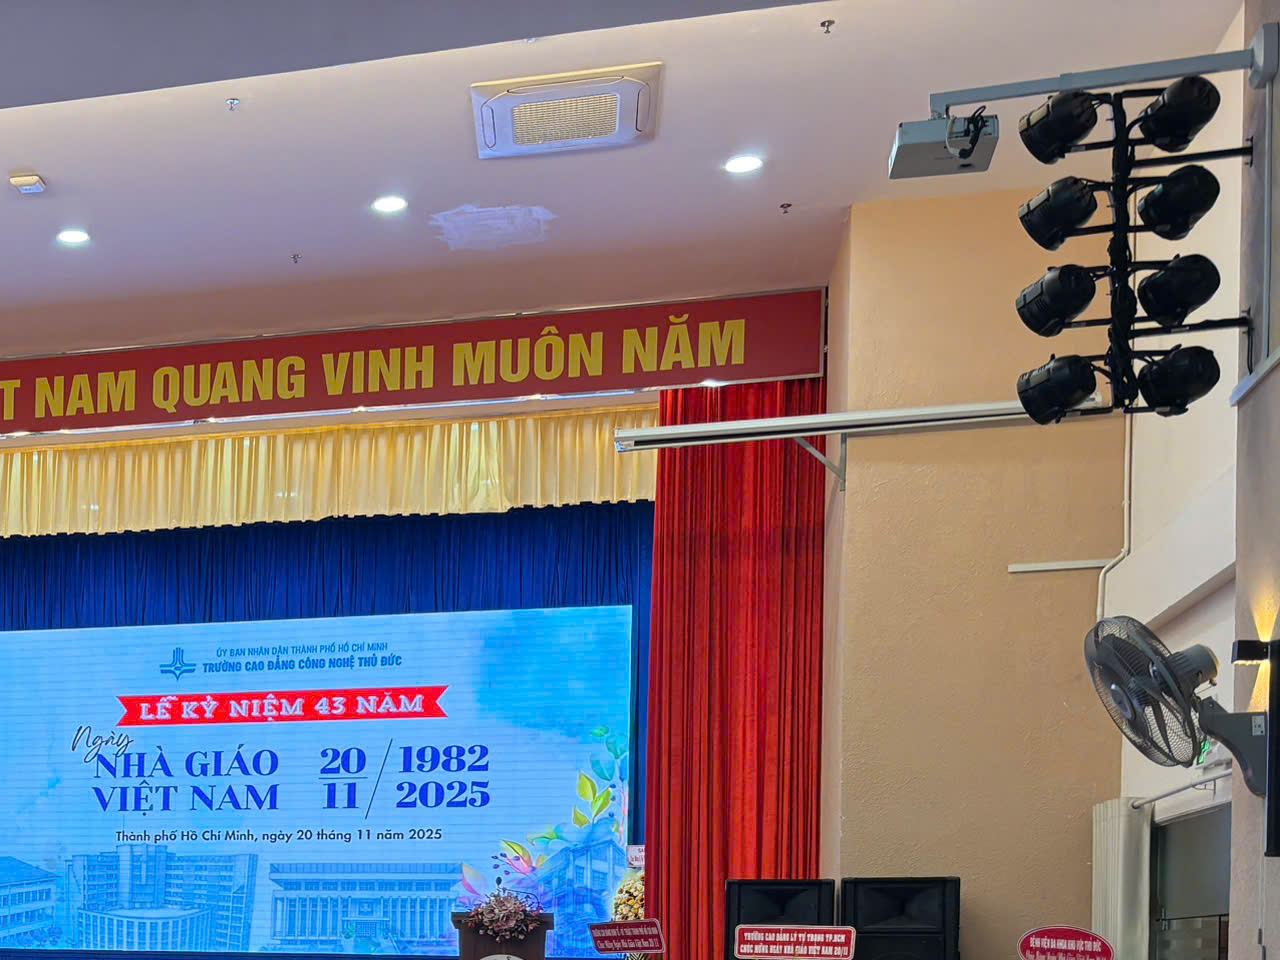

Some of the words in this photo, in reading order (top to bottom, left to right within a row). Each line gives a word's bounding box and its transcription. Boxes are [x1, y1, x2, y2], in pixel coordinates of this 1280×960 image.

[34, 370, 136, 418] NAM
[152, 356, 307, 413] QUANG
[322, 345, 435, 396] VINH
[452, 325, 604, 387] MUÔN
[622, 313, 746, 375] NĂM
[202, 659, 242, 673] TRƯỜNG
[245, 661, 265, 672] CAO
[267, 655, 295, 671] ĐẲNG
[298, 656, 326, 670] CÔNG
[328, 655, 355, 670] NGHỆ
[357, 653, 378, 668] THỦ
[380, 652, 402, 667] ĐỨC
[229, 648, 246, 657] BAN
[248, 646, 269, 657] NHÂN
[272, 644, 289, 656] DÂN
[352, 641, 365, 653] CHÍ
[367, 641, 388, 652] MINH
[139, 694, 171, 721] LỄ
[181, 695, 218, 720] KỶ
[229, 693, 305, 722] NIỆM
[313, 696, 347, 717] 43
[355, 693, 425, 715] NĂM
[71, 725, 134, 763] Ngày
[397, 744, 490, 773] 1982
[94, 748, 174, 779] NHÀ
[184, 744, 279, 778] GIÁO
[319, 747, 367, 775] 20
[91, 780, 178, 816] VIỆT
[189, 783, 280, 811] NAM
[321, 782, 359, 810] 11
[395, 780, 491, 809] 2025
[115, 829, 149, 842] Thành
[153, 830, 178, 845] phố
[180, 829, 198, 841] Hồ
[201, 828, 222, 841] Chí
[224, 829, 258, 843] Minh,
[261, 831, 294, 844] ngày
[296, 830, 313, 841] 20
[316, 828, 354, 843] tháng
[358, 829, 372, 840] 11
[376, 829, 405, 840] năm
[408, 829, 442, 841] 2025
[765, 932, 775, 941] CAO
